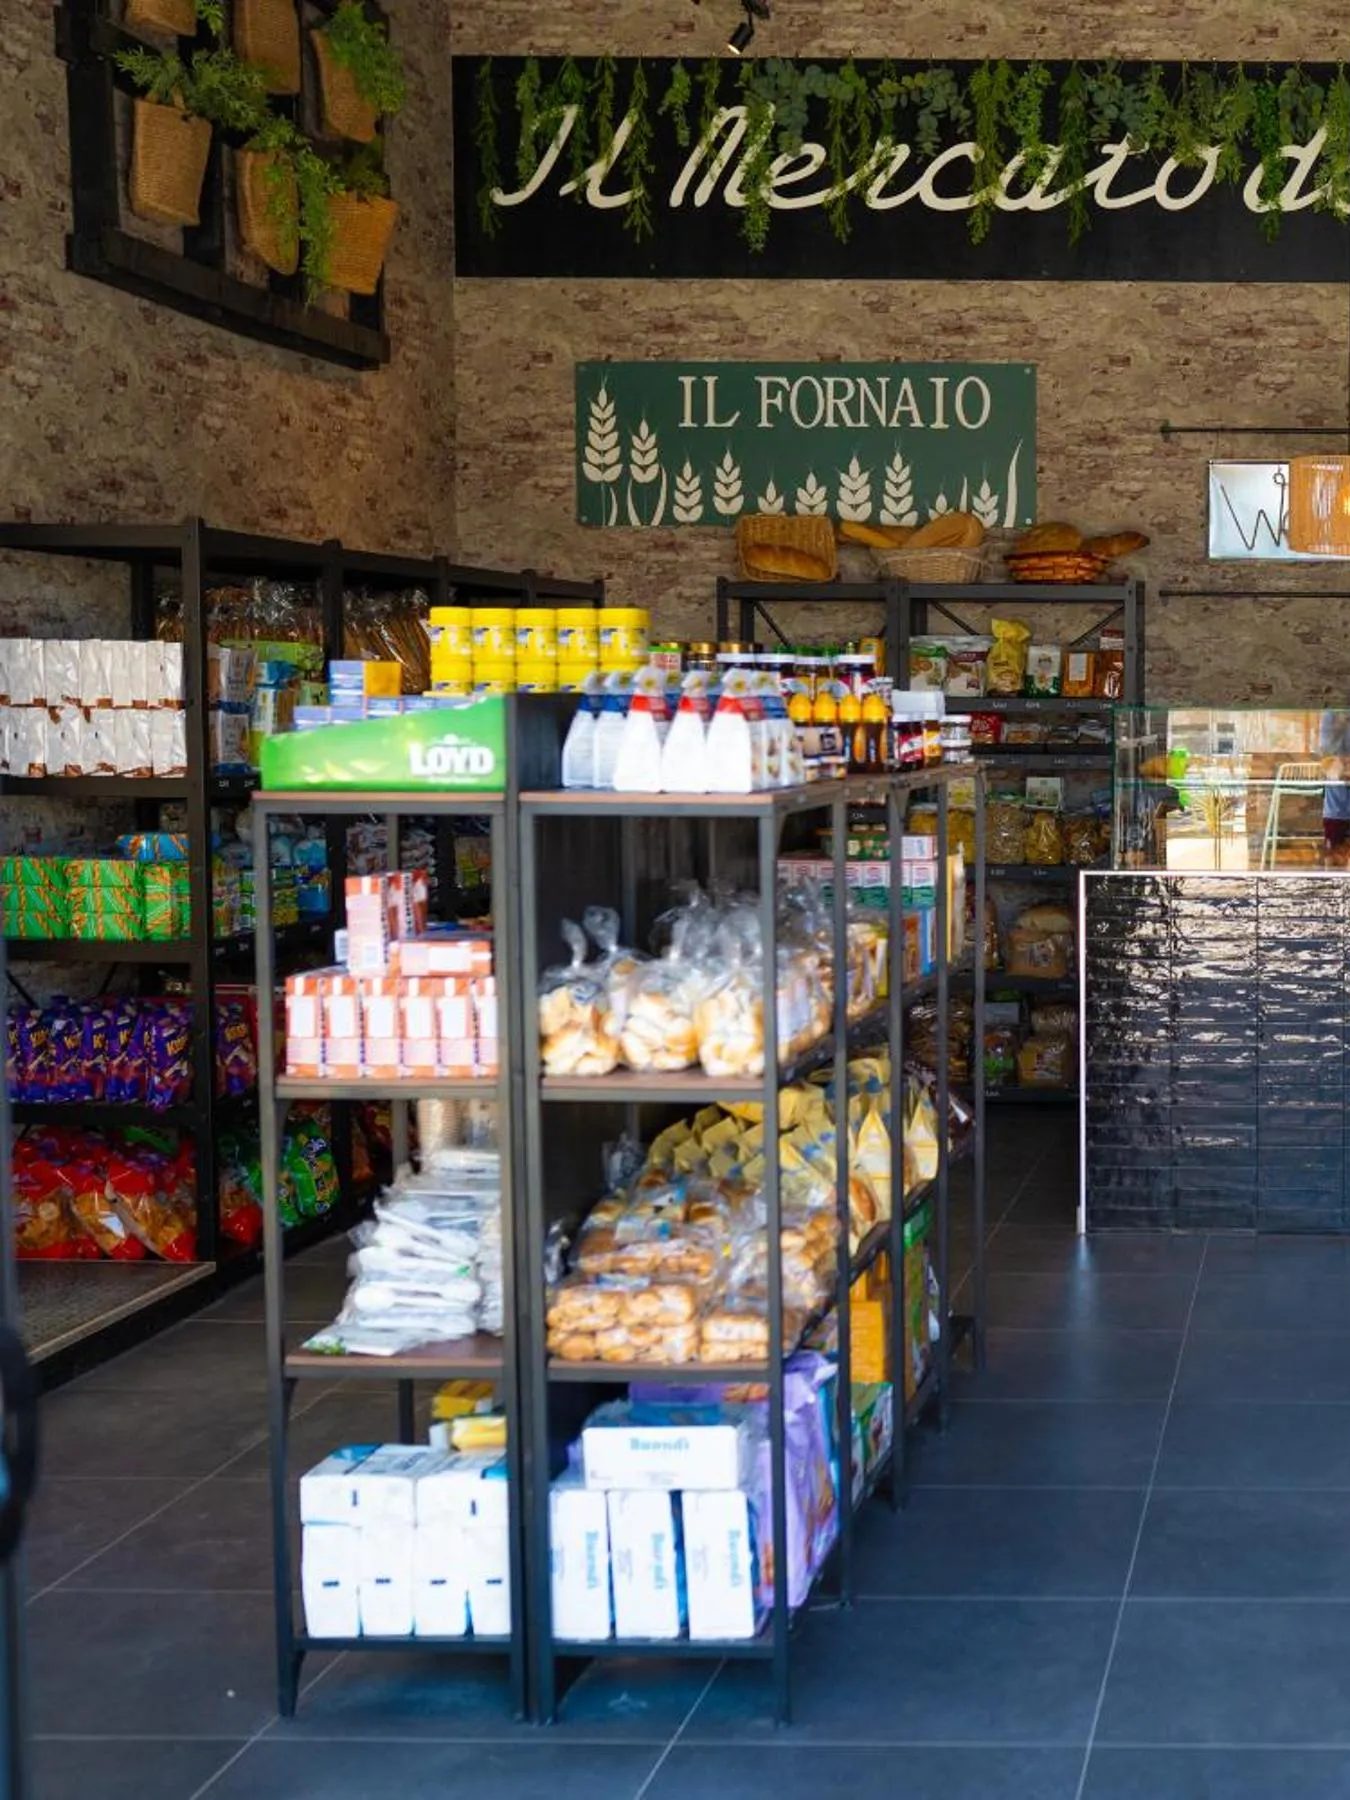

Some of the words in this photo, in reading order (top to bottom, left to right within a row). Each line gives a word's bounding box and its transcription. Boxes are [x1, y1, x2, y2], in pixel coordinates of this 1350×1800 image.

[489, 103, 645, 210] Il
[668, 104, 1221, 212] Mercato
[678, 375, 741, 428] IL
[754, 375, 992, 429] FORNAIO
[409, 742, 495, 776] LOYD
